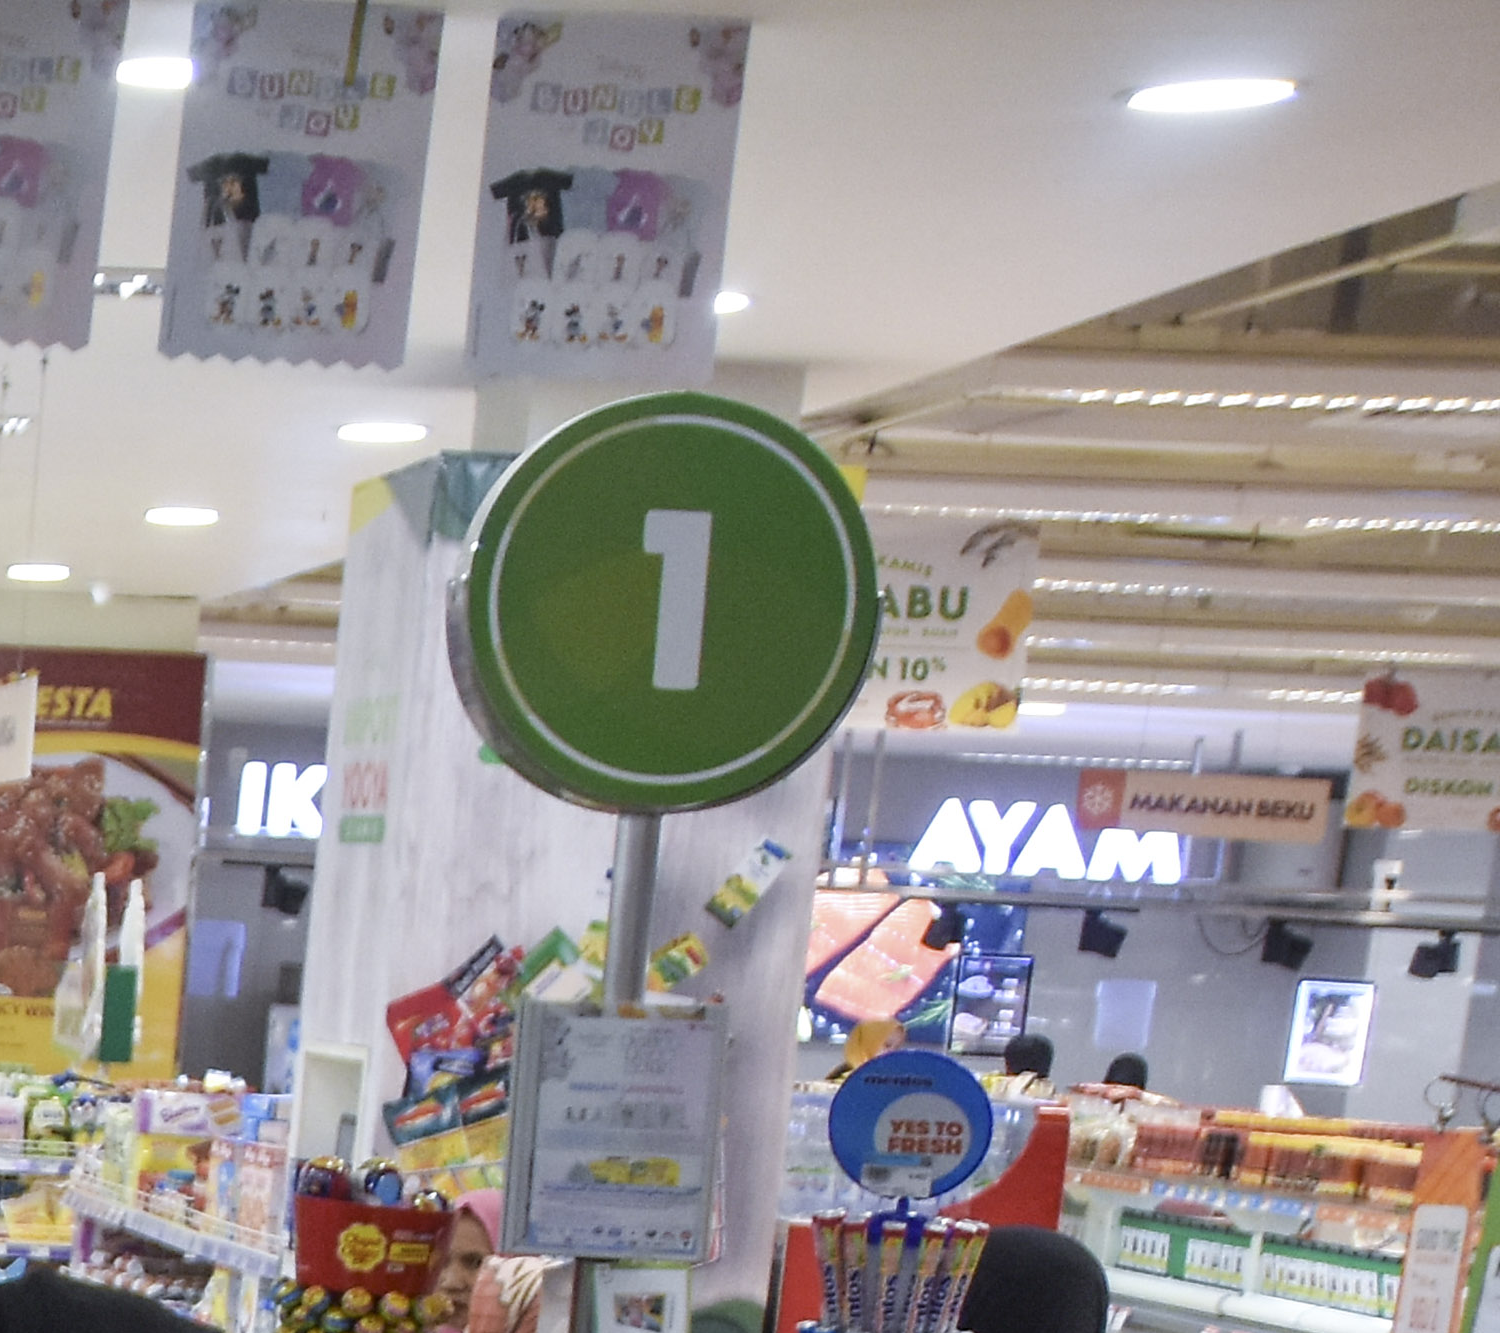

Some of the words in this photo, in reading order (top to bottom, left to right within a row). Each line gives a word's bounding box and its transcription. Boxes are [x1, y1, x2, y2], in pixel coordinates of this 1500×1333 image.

[642, 508, 714, 691] 1
[37, 685, 114, 720] ESTA
[234, 760, 330, 838] IK
[1129, 792, 1252, 819] MAKANAN
[1254, 795, 1316, 822] BEKU
[908, 796, 1183, 886] AYAM
[889, 1118, 930, 1137] YES
[935, 1119, 964, 1137] TO
[887, 1135, 963, 1156] FRESH
